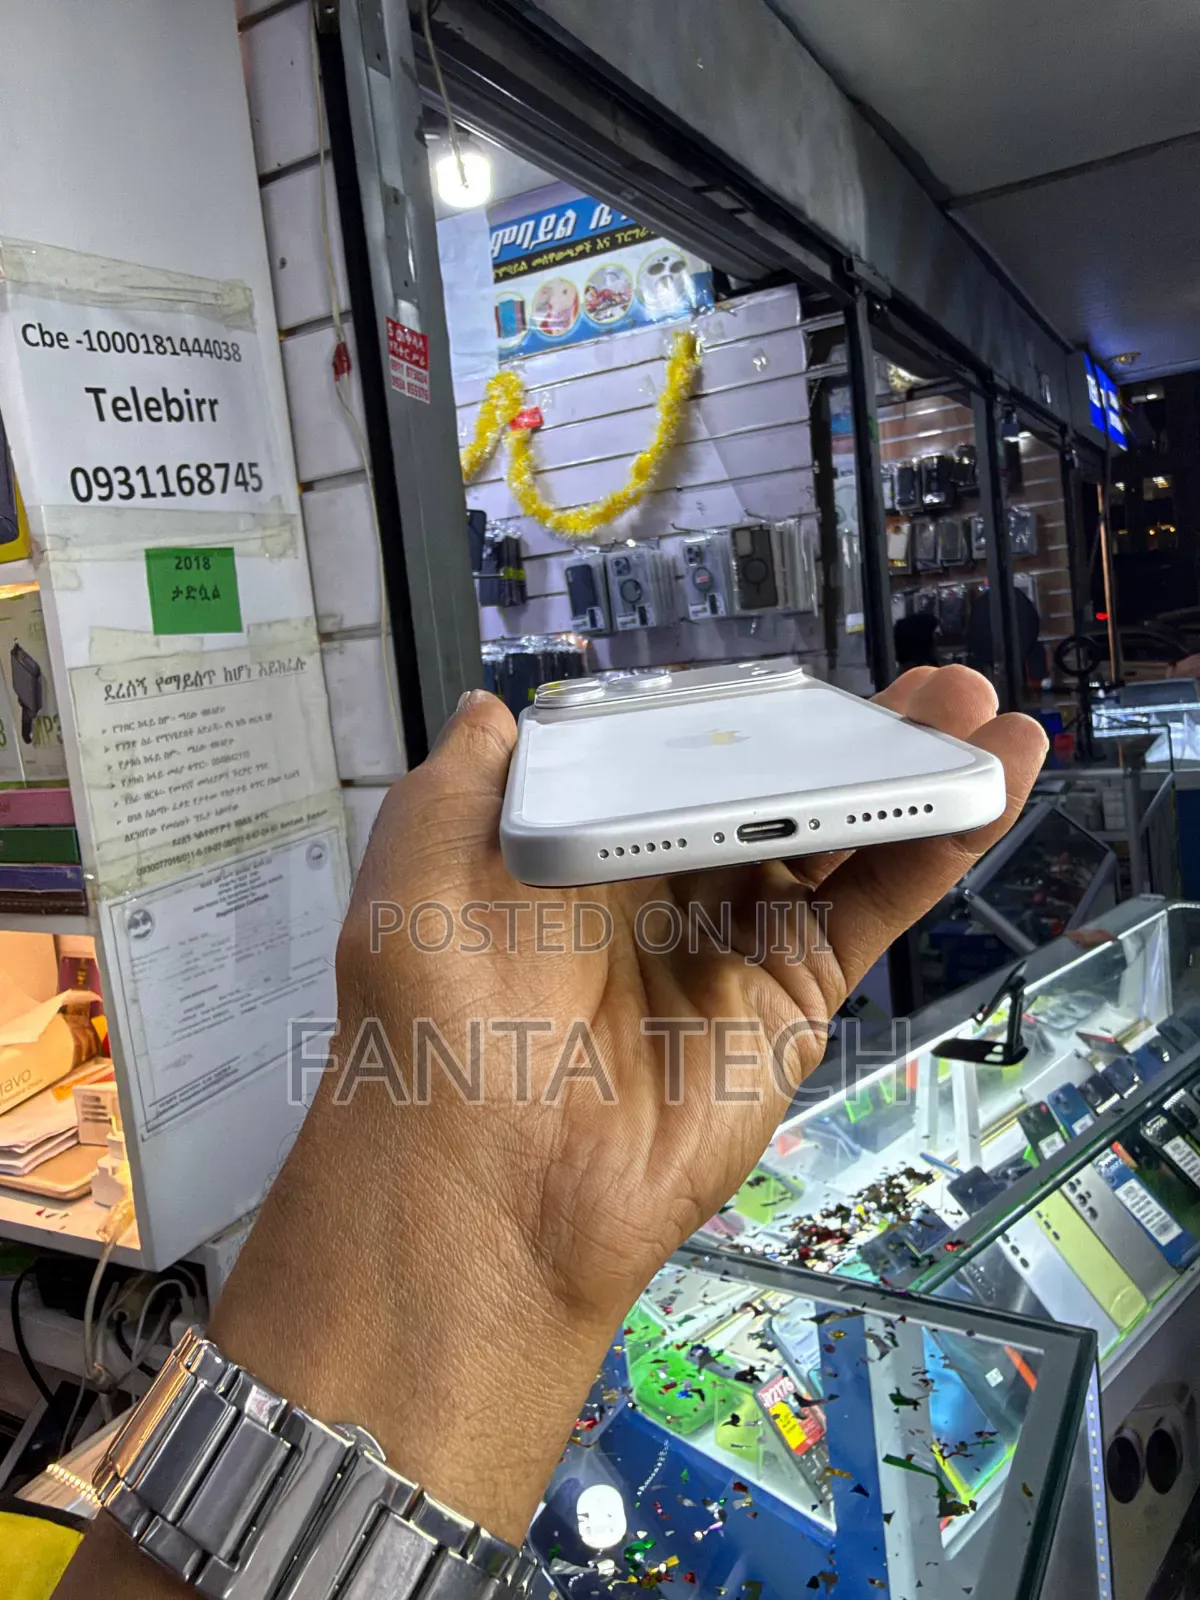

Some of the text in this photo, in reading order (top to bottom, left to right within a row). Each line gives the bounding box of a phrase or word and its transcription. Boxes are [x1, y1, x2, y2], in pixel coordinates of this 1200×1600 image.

[21, 323, 70, 351] Cbe
[85, 386, 220, 423] Telebirr
[70, 461, 263, 503] 0931168745
[175, 556, 211, 571] 2018
